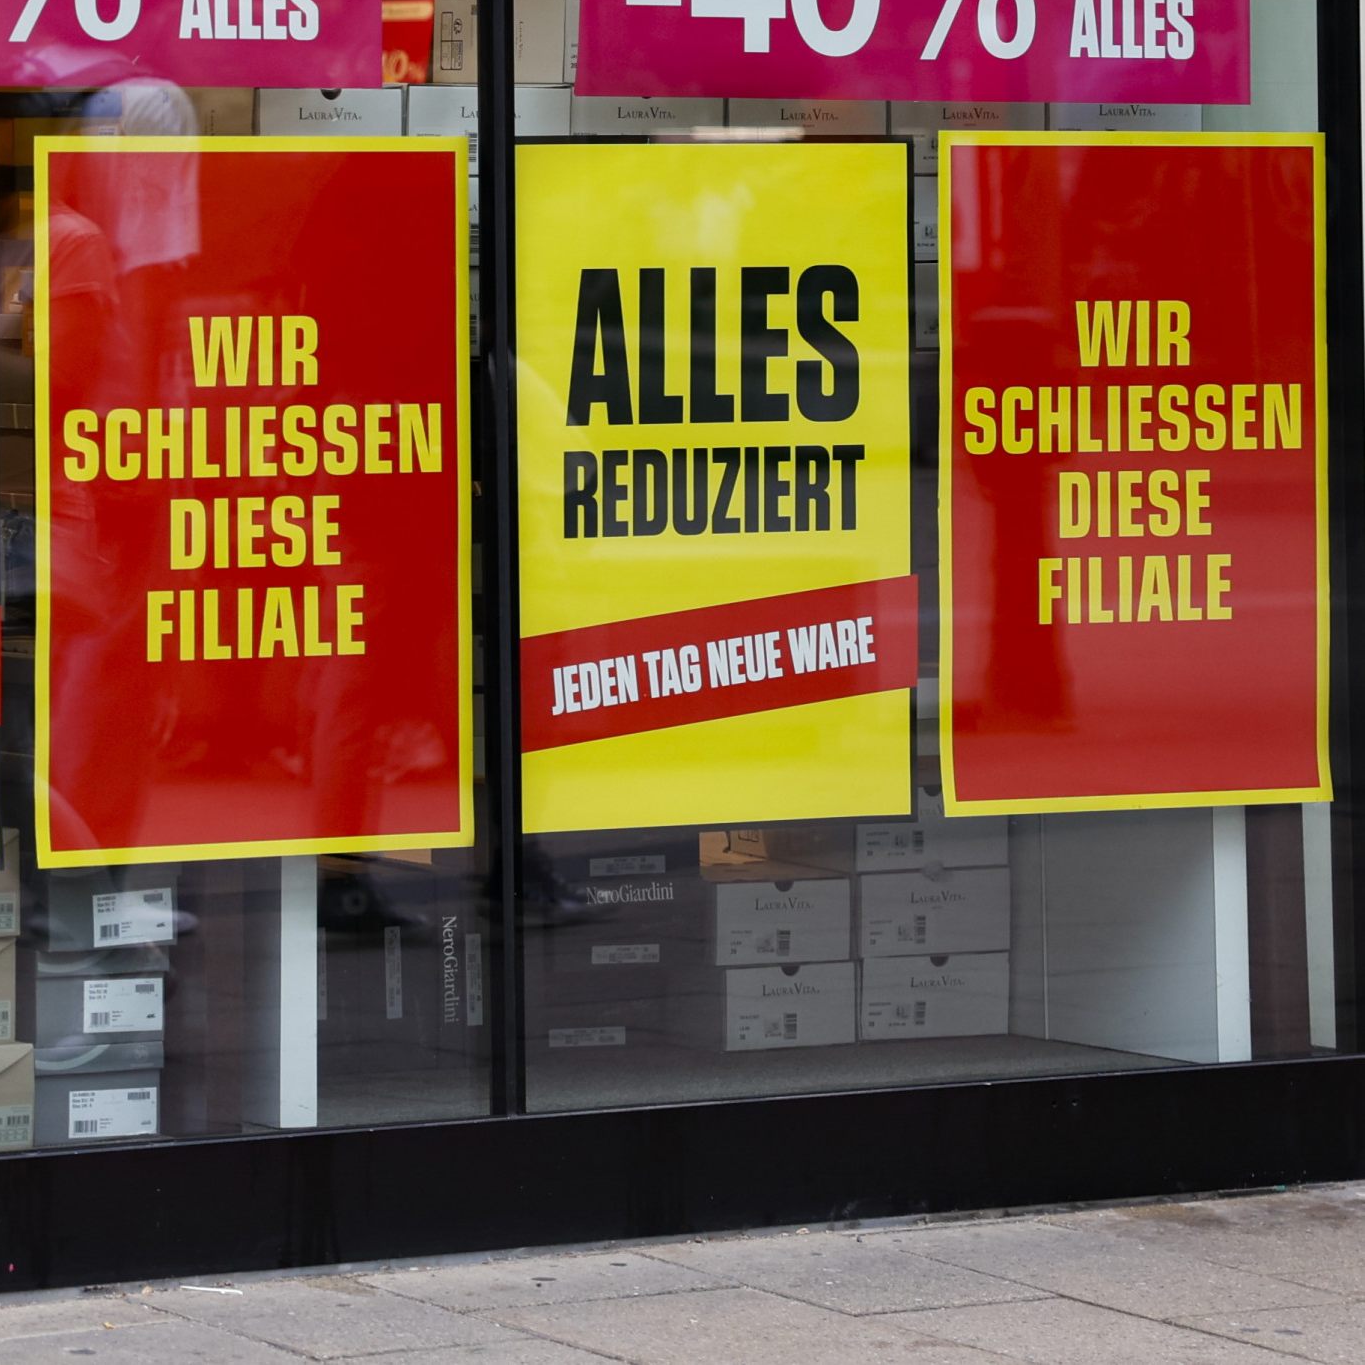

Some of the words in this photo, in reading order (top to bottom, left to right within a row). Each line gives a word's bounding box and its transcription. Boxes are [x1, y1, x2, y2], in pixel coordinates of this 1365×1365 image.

[189, 316, 317, 387] WIR
[567, 265, 859, 426] ALLES
[1076, 301, 1190, 366] WIR
[64, 404, 441, 481] SCHLIESSEN
[965, 384, 1301, 454] SCHLIESSEN
[564, 445, 864, 538] REDUZIERT
[1060, 470, 1211, 538] DIESE
[171, 496, 340, 569] DIESE
[147, 585, 365, 661] FILIALE
[1039, 554, 1232, 624] FILIALE
[553, 655, 638, 715] JEDEN
[643, 645, 701, 698] TAG
[707, 632, 783, 688] NEUE
[788, 617, 875, 674] WARE
[586, 882, 675, 905] NeroGiardini
[442, 915, 460, 1023] NeroGiardini
